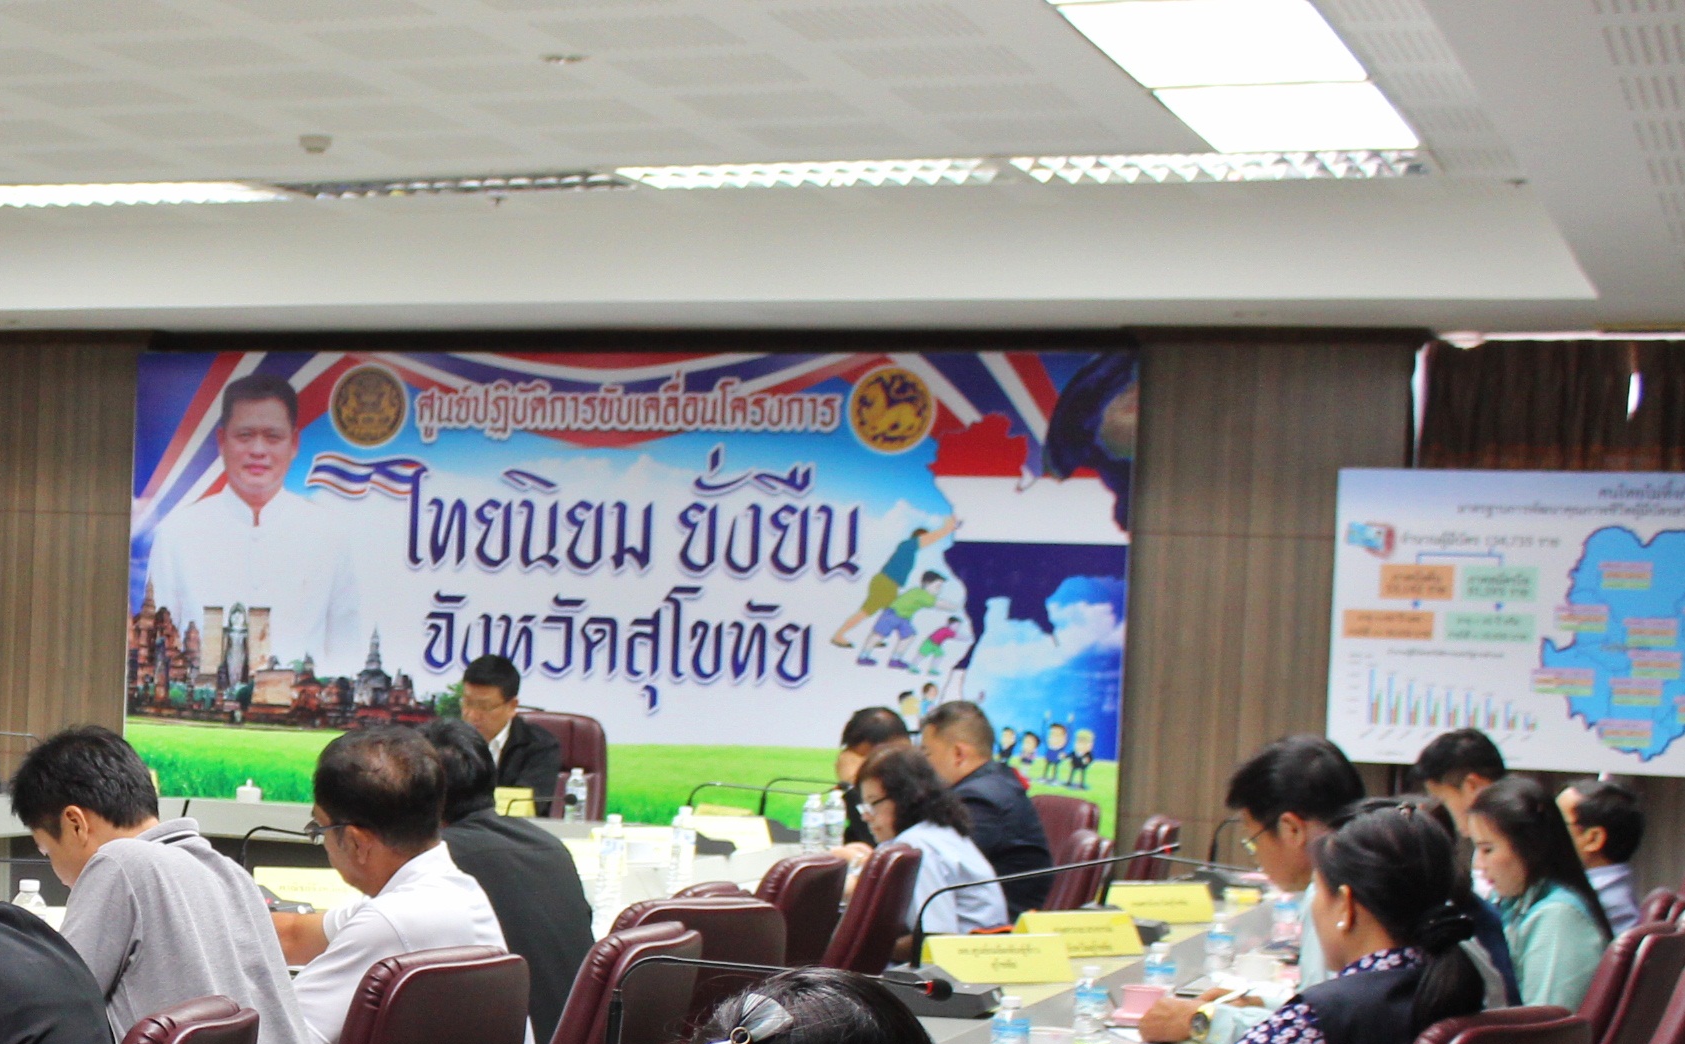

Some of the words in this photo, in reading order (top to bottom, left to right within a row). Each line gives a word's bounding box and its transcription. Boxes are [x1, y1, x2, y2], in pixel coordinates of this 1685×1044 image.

[416, 373, 840, 441] ศูนย์ปฏิบัติการขับเคลื่อนโครงการ
[408, 457, 654, 572] ไทยนิยม
[678, 446, 861, 576] ยั่งยืน
[423, 586, 813, 711] จังหวัดสุโขทัย
